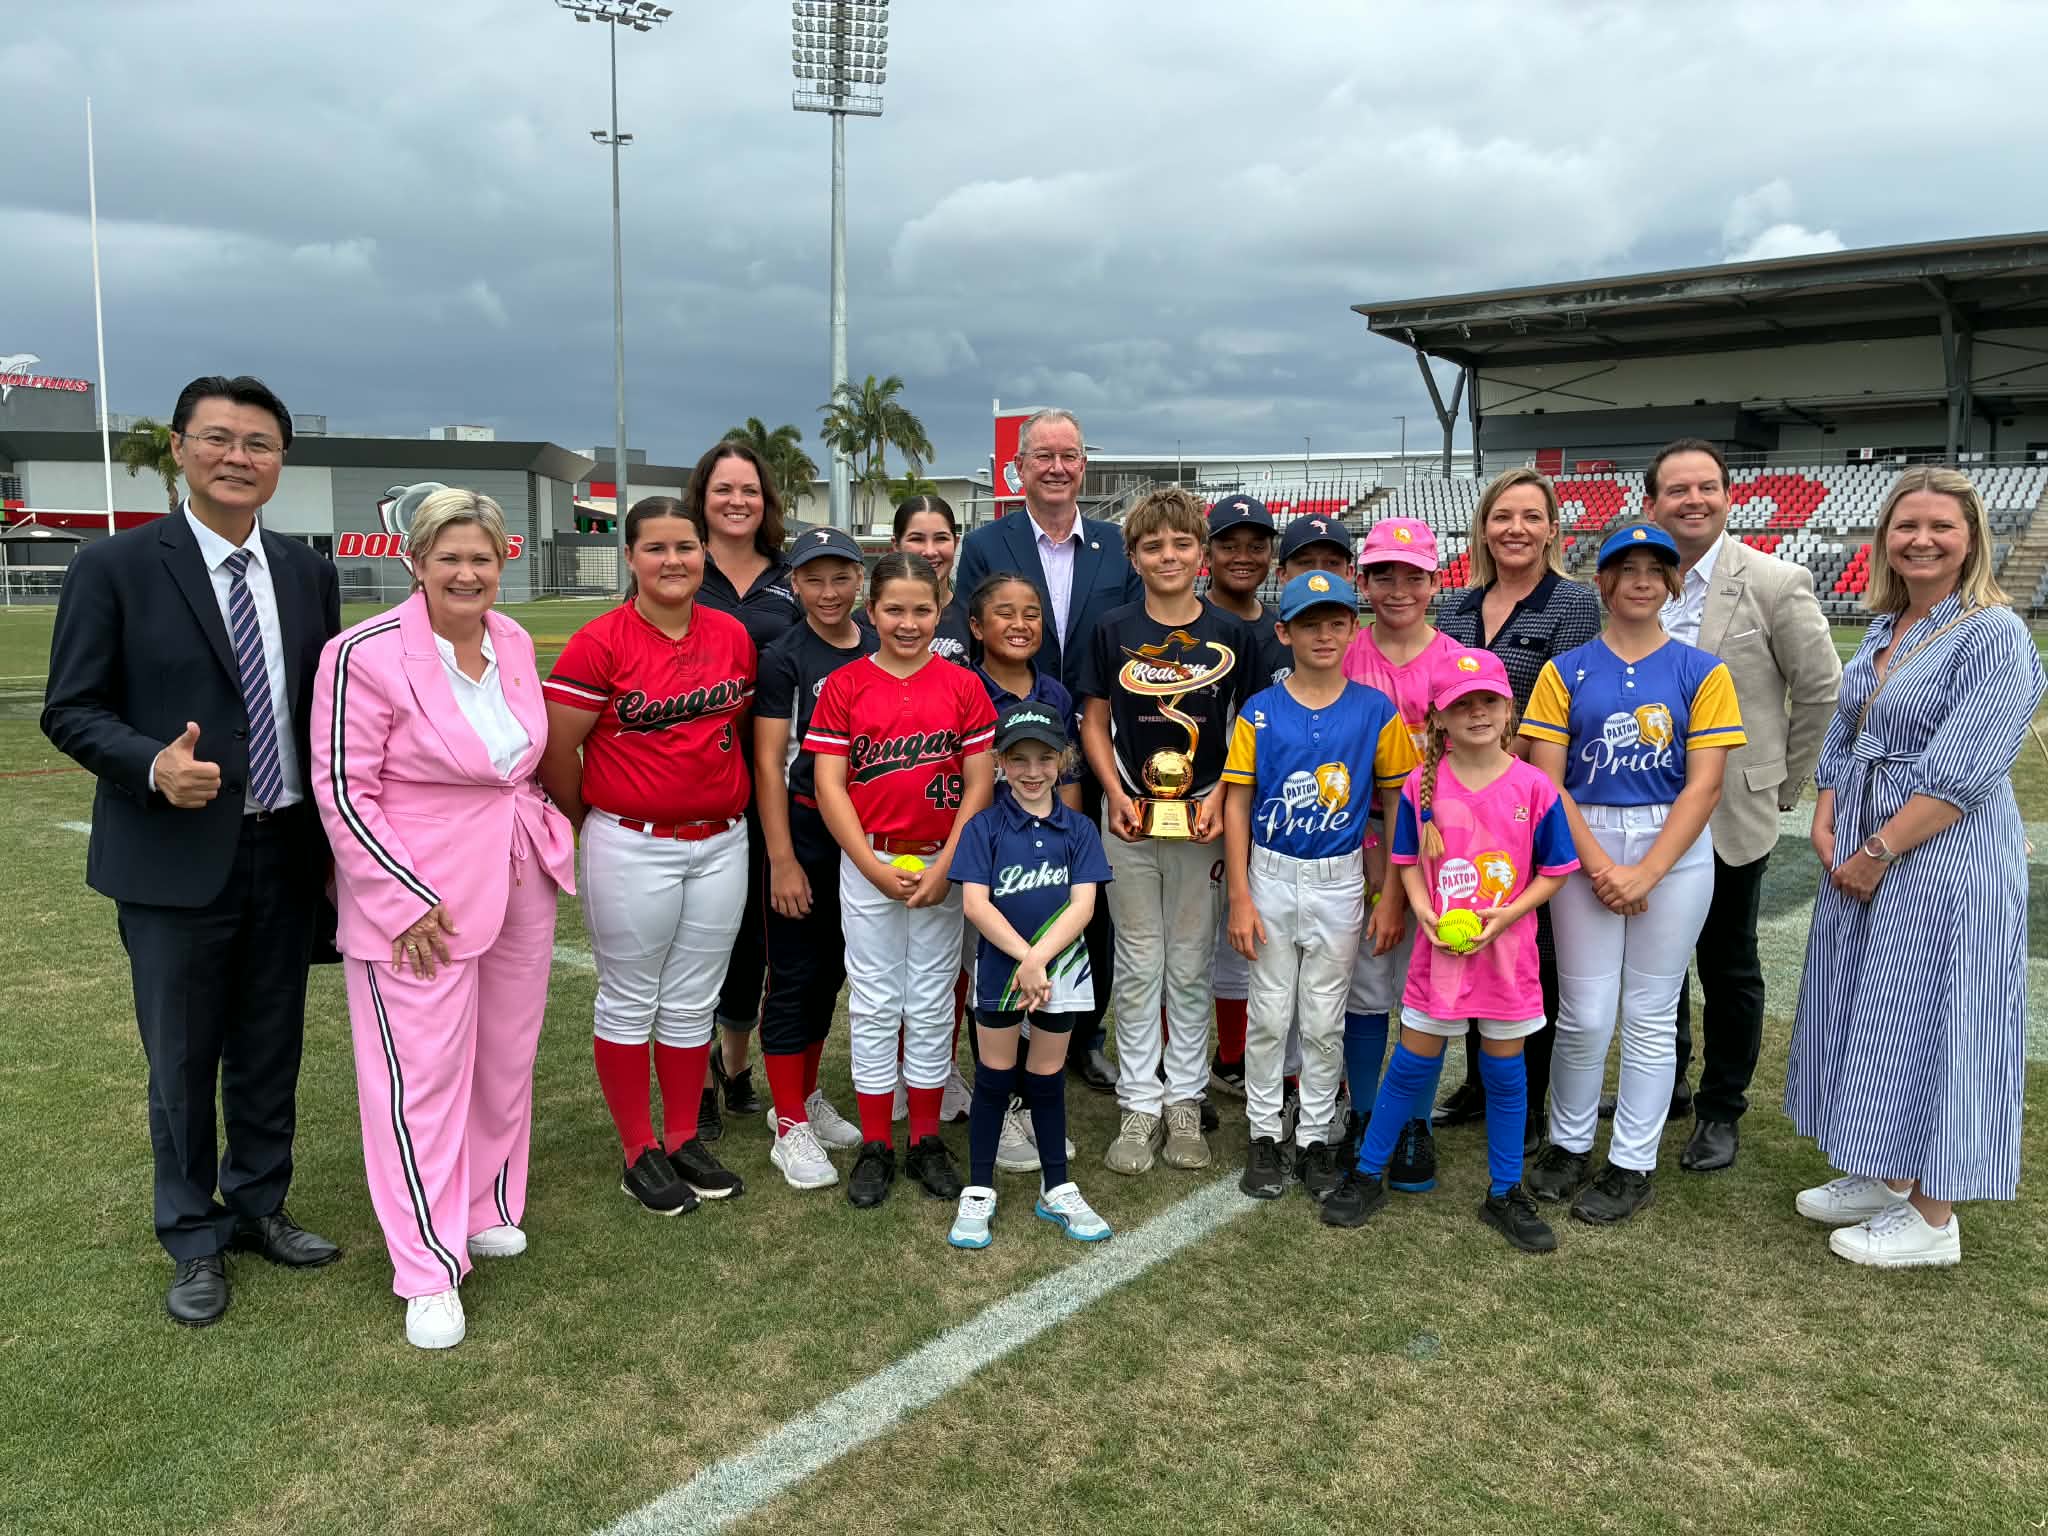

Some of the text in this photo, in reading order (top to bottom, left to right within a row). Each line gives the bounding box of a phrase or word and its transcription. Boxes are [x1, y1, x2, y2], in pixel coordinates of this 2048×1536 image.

[0, 373, 89, 392] DOLPHINS
[336, 532, 525, 559] DOLS
[928, 637, 964, 655] liffe
[1133, 662, 1211, 684] Redcff
[1004, 710, 1051, 728] Lakers
[718, 721, 733, 752] 3
[1606, 722, 1638, 741] PAXTON
[1581, 737, 1673, 785] Pride
[925, 773, 964, 810] 49
[1286, 782, 1317, 801] PAXTON
[1257, 797, 1351, 843] Pride
[994, 860, 1069, 898] Laker
[1442, 871, 1477, 891] PAXTON
